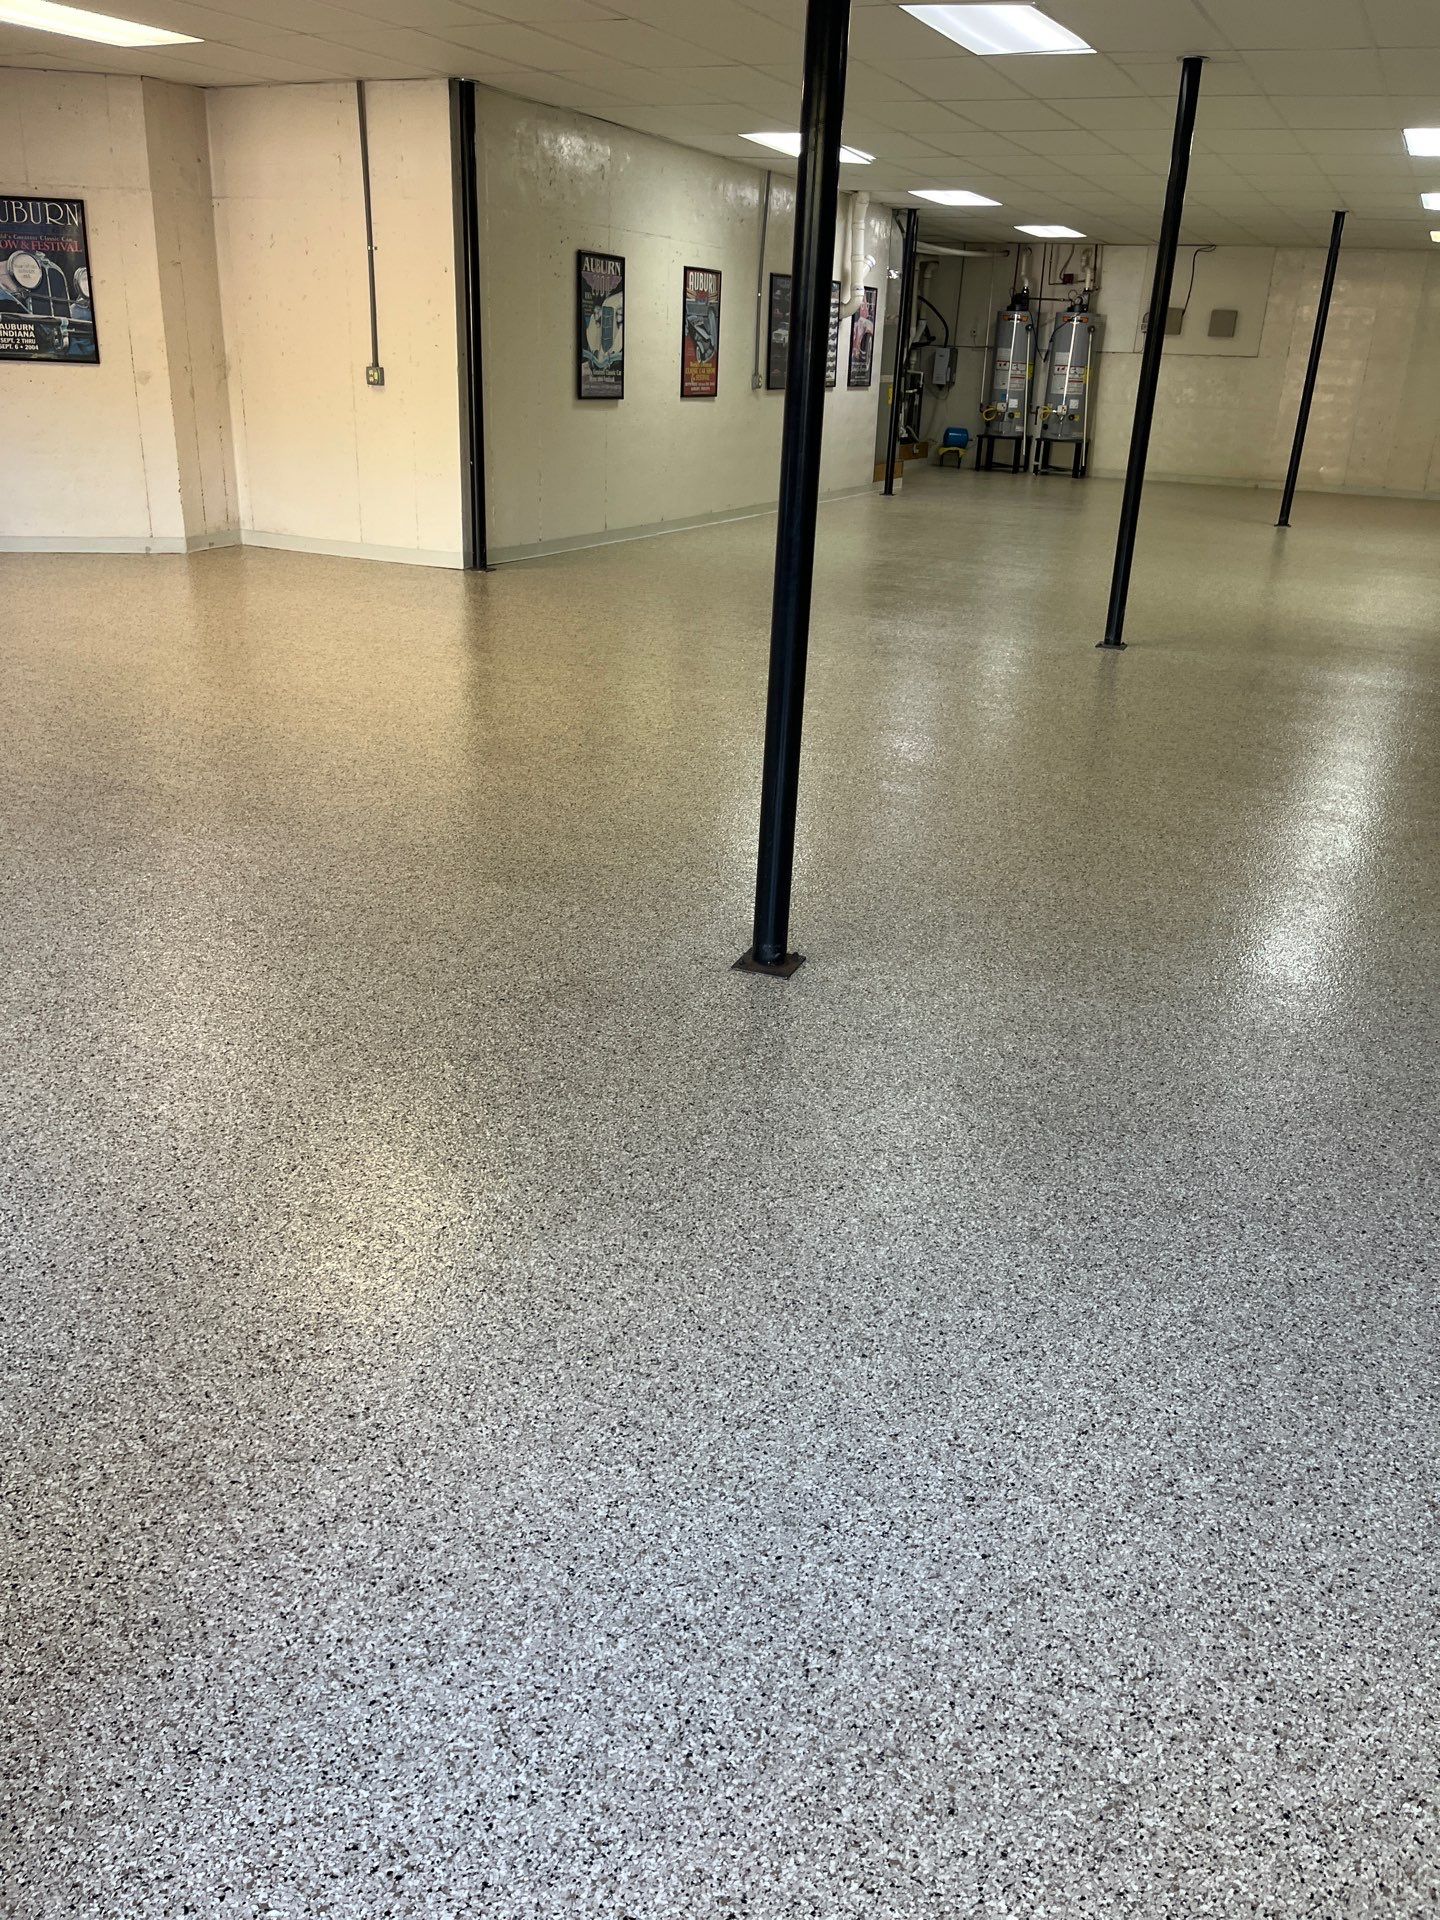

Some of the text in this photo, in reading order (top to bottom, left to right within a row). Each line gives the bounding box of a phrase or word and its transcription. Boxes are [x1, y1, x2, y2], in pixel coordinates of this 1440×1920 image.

[21, 240, 30, 250] &
[32, 241, 82, 253] FESTIVAL
[583, 256, 621, 276] AUBURN
[689, 271, 717, 294] AUBURN
[0, 323, 34, 331] AUBURN
